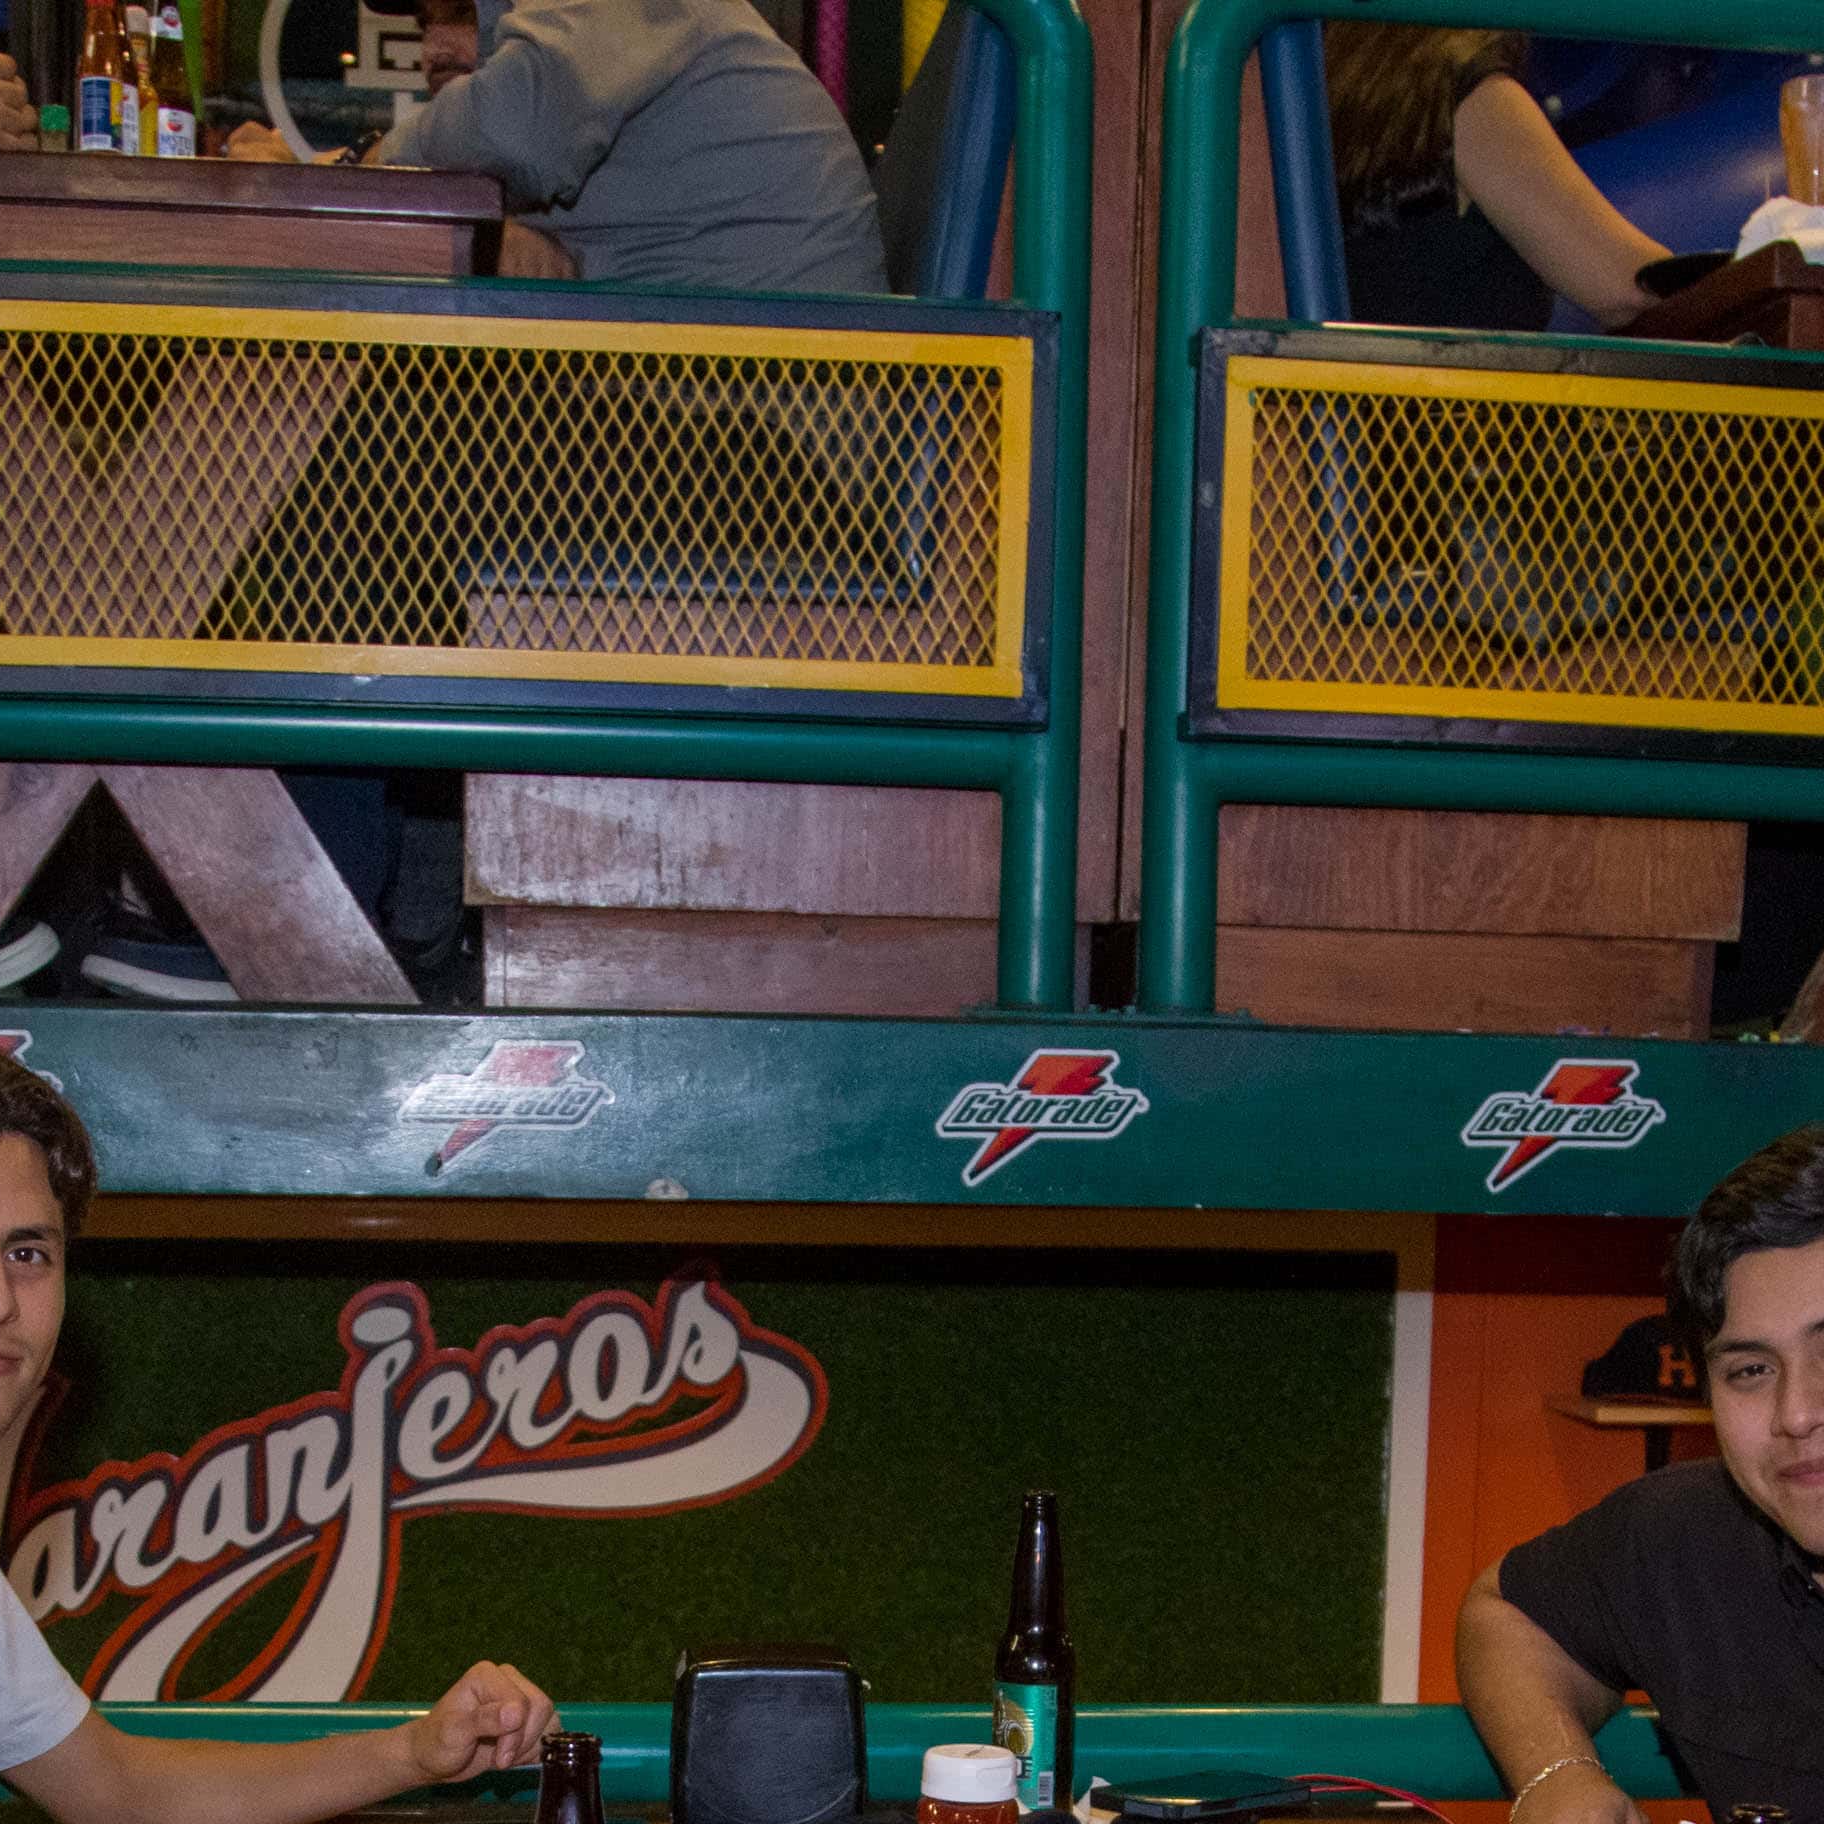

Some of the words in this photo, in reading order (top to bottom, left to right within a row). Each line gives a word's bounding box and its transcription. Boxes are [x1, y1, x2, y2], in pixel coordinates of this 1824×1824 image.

[950, 1092, 1120, 1124] Gatorade
[1476, 1101, 1639, 1133] Gatorade
[1658, 1343, 1697, 1389] H
